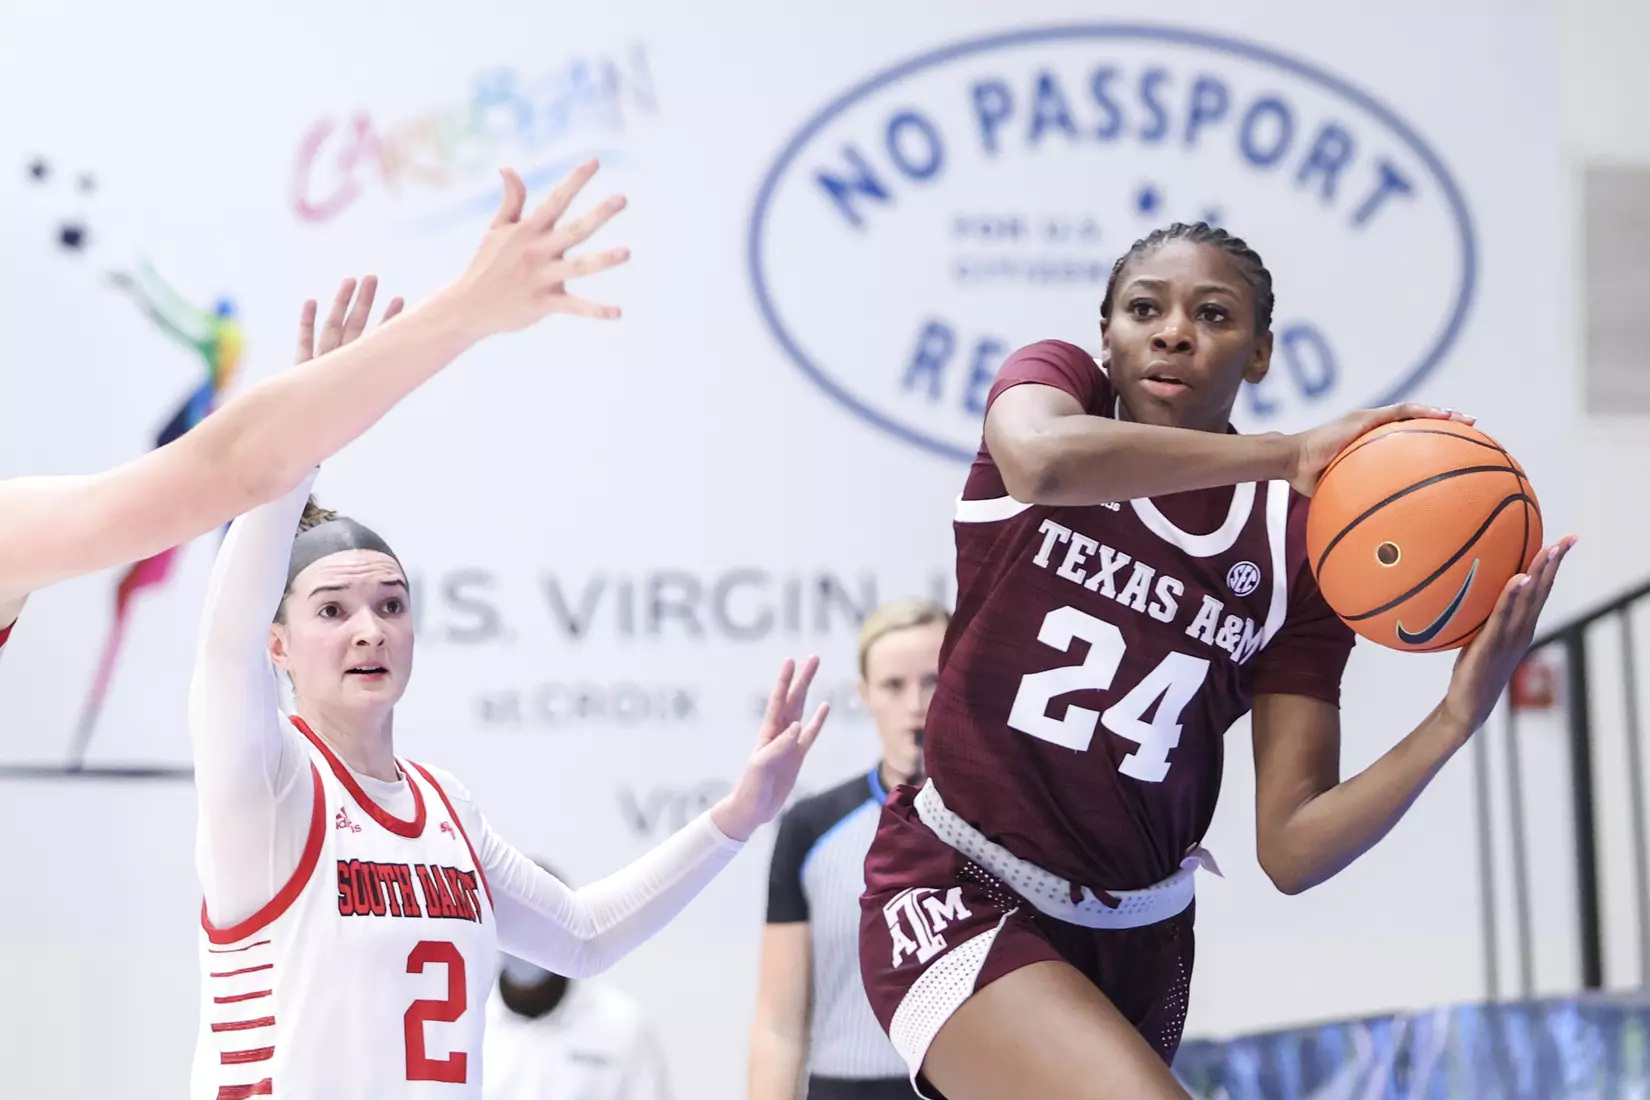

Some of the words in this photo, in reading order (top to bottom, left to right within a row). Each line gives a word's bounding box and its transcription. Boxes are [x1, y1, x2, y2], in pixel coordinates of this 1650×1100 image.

[814, 108, 946, 230] NO
[970, 64, 1416, 231] PASSPORT
[541, 566, 878, 643] VIRGIN
[1032, 518, 1185, 624] TEXAS
[1185, 594, 1265, 665] A&M
[1229, 564, 1257, 593] SEC
[1006, 605, 1211, 782] 24
[337, 858, 422, 918] SOUTH
[404, 940, 467, 1083] 2
